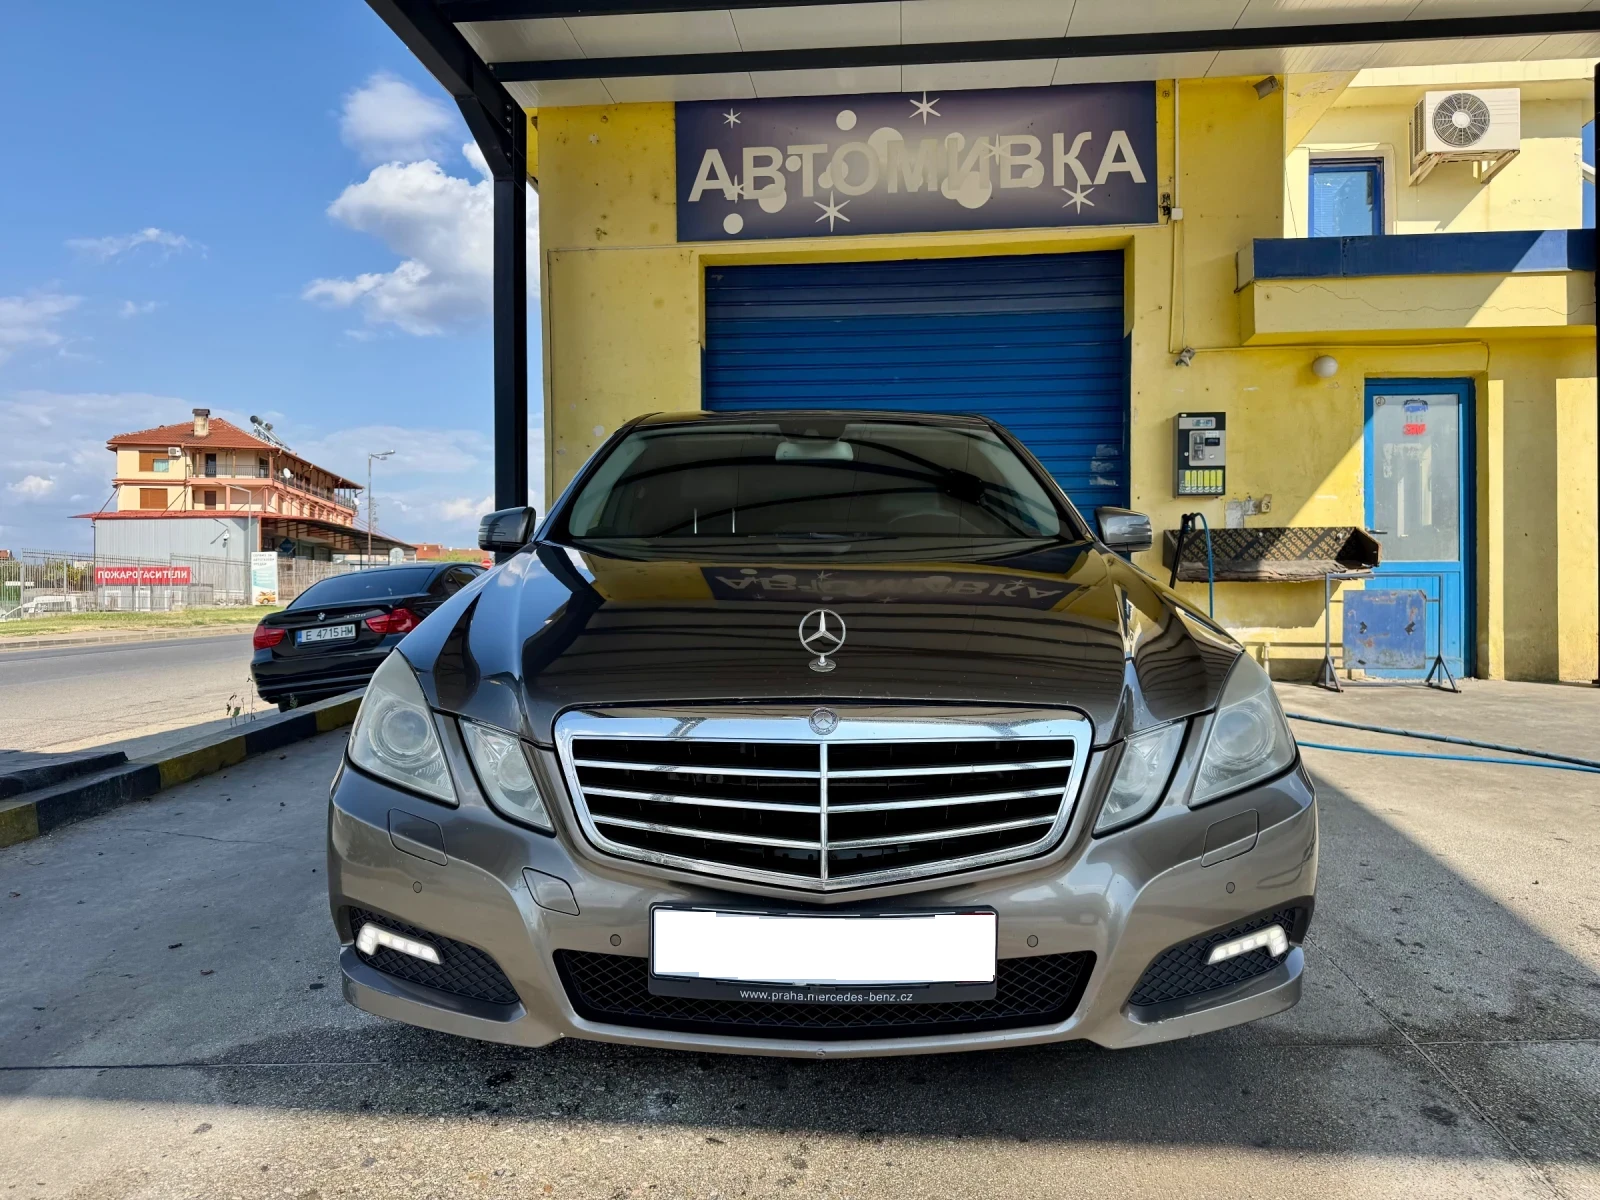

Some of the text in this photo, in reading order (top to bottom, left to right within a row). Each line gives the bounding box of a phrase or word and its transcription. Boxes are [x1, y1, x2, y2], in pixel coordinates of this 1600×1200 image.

[687, 130, 1147, 203] АВТОМИВКА
[97, 570, 188, 579] ПОЖАРОГАСИТЕЛИ
[316, 627, 340, 639] 4715
[340, 625, 354, 637] HM
[740, 990, 913, 1002] www.praha.mercedes-benz.cz
